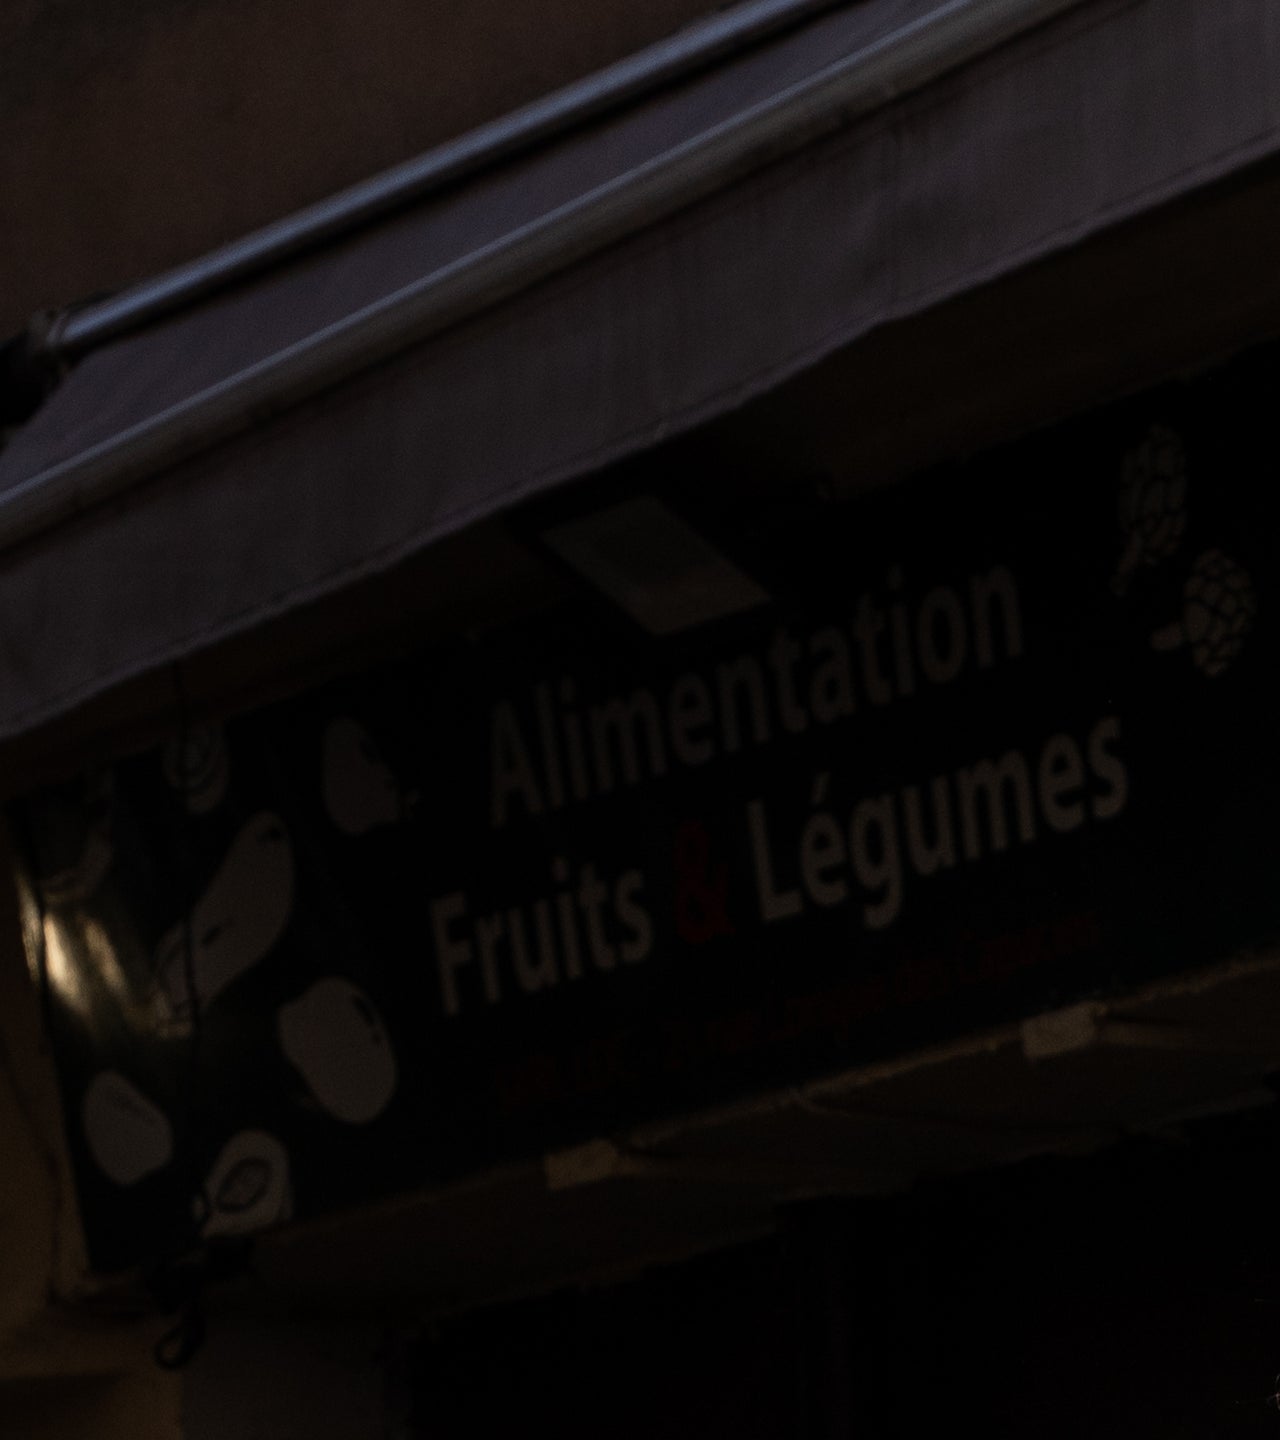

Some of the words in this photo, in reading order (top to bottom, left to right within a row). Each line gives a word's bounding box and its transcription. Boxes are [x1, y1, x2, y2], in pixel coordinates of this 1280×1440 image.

[488, 561, 1025, 832] Alimentation
[428, 854, 657, 1018] Fruits
[745, 714, 1130, 932] Légumes
